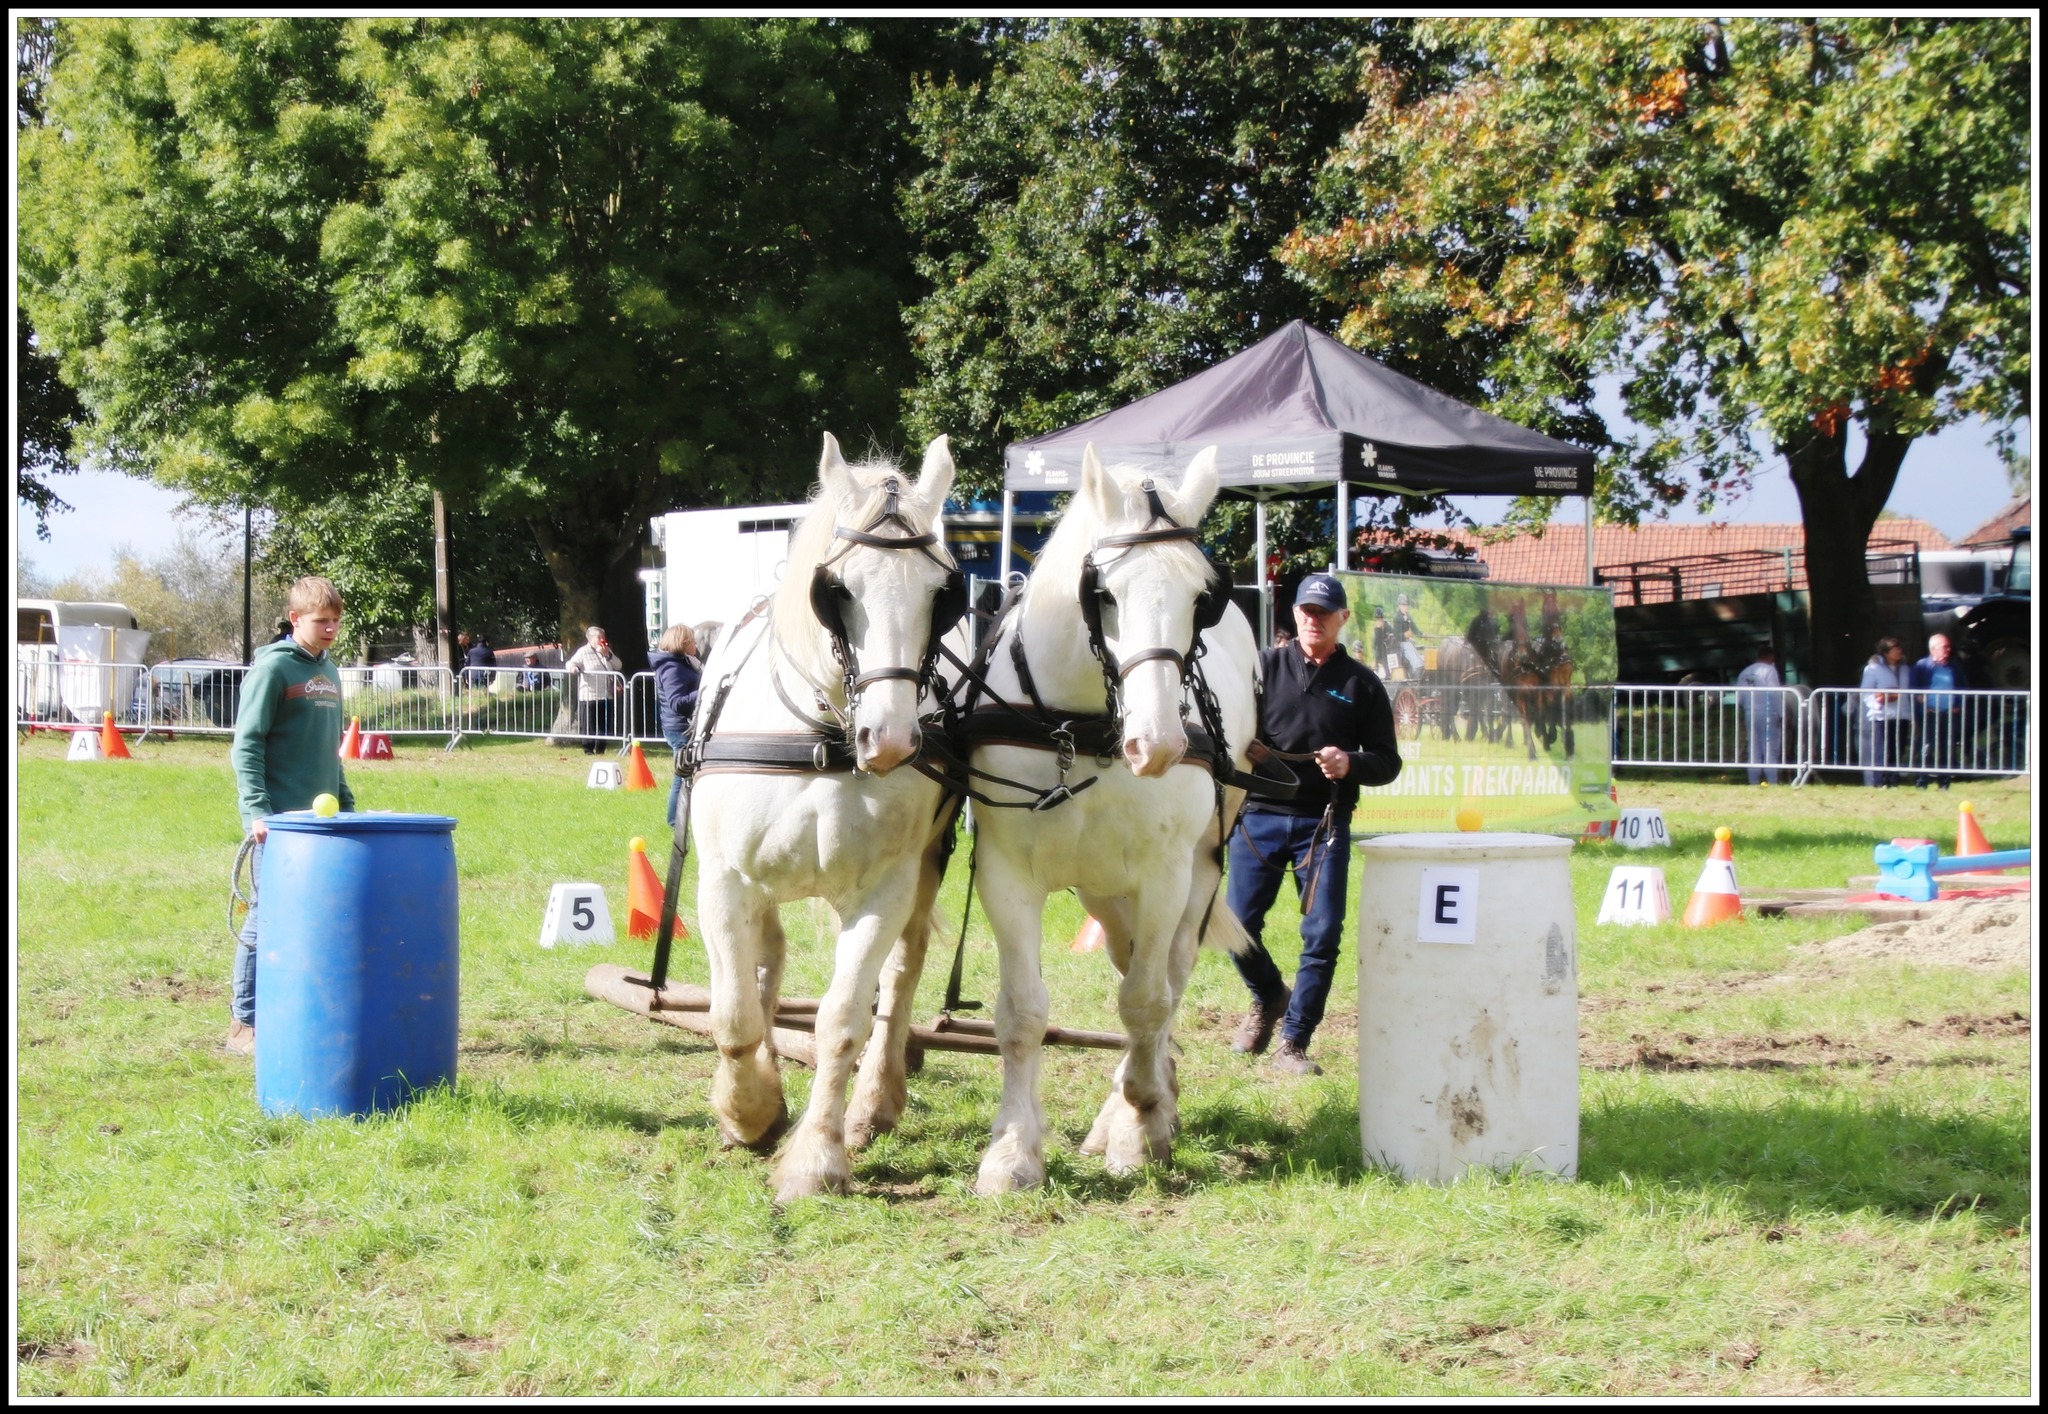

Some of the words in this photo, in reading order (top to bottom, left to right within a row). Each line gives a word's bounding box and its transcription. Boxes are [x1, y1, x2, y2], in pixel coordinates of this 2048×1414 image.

[1252, 454, 1264, 467] DE
[1266, 451, 1315, 466] PROVINCIE
[1252, 469, 1270, 479] JOUW
[1271, 466, 1315, 478] STREEKMOTOR
[1533, 466, 1544, 478] DE
[1544, 466, 1578, 479] PROVINCIE
[77, 736, 88, 751] A
[376, 738, 389, 754] A
[1401, 742, 1421, 760] HET
[595, 769, 609, 785] D
[616, 769, 622, 785] D
[1361, 764, 1454, 796] BANTS
[1461, 764, 1571, 796] TREKPAARD
[1366, 807, 1397, 822] zondag
[1415, 807, 1449, 819] oktober
[1620, 817, 1640, 839] 10
[1647, 816, 1664, 838] 10
[1616, 879, 1644, 910] 11
[1435, 885, 1460, 924] E
[572, 897, 595, 931] 5
